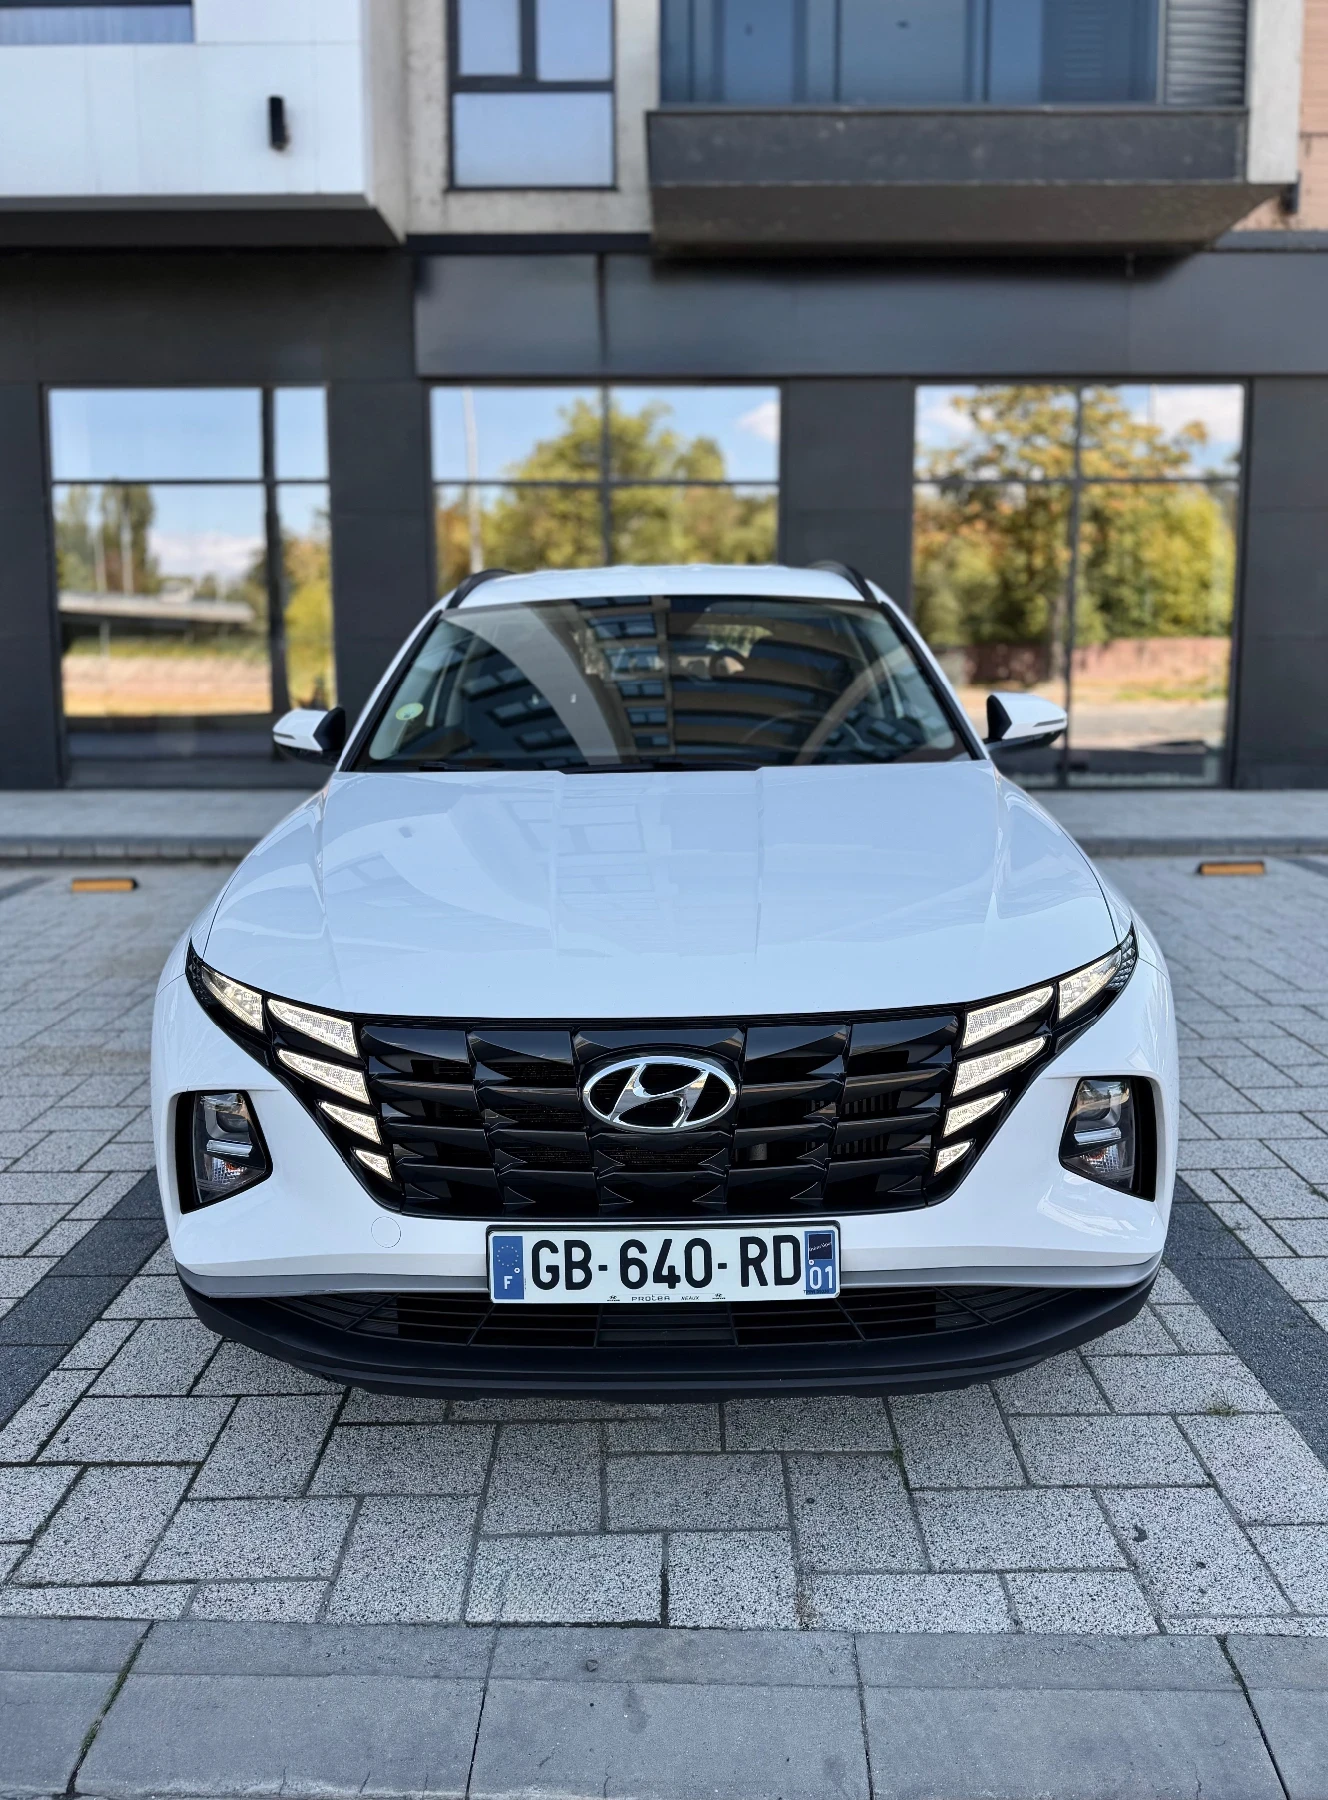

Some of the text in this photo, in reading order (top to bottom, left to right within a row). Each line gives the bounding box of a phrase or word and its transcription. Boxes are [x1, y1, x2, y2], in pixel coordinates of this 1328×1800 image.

[531, 1234, 802, 1291] GB-640-RD
[503, 1275, 513, 1291] F
[809, 1265, 834, 1290] 01
